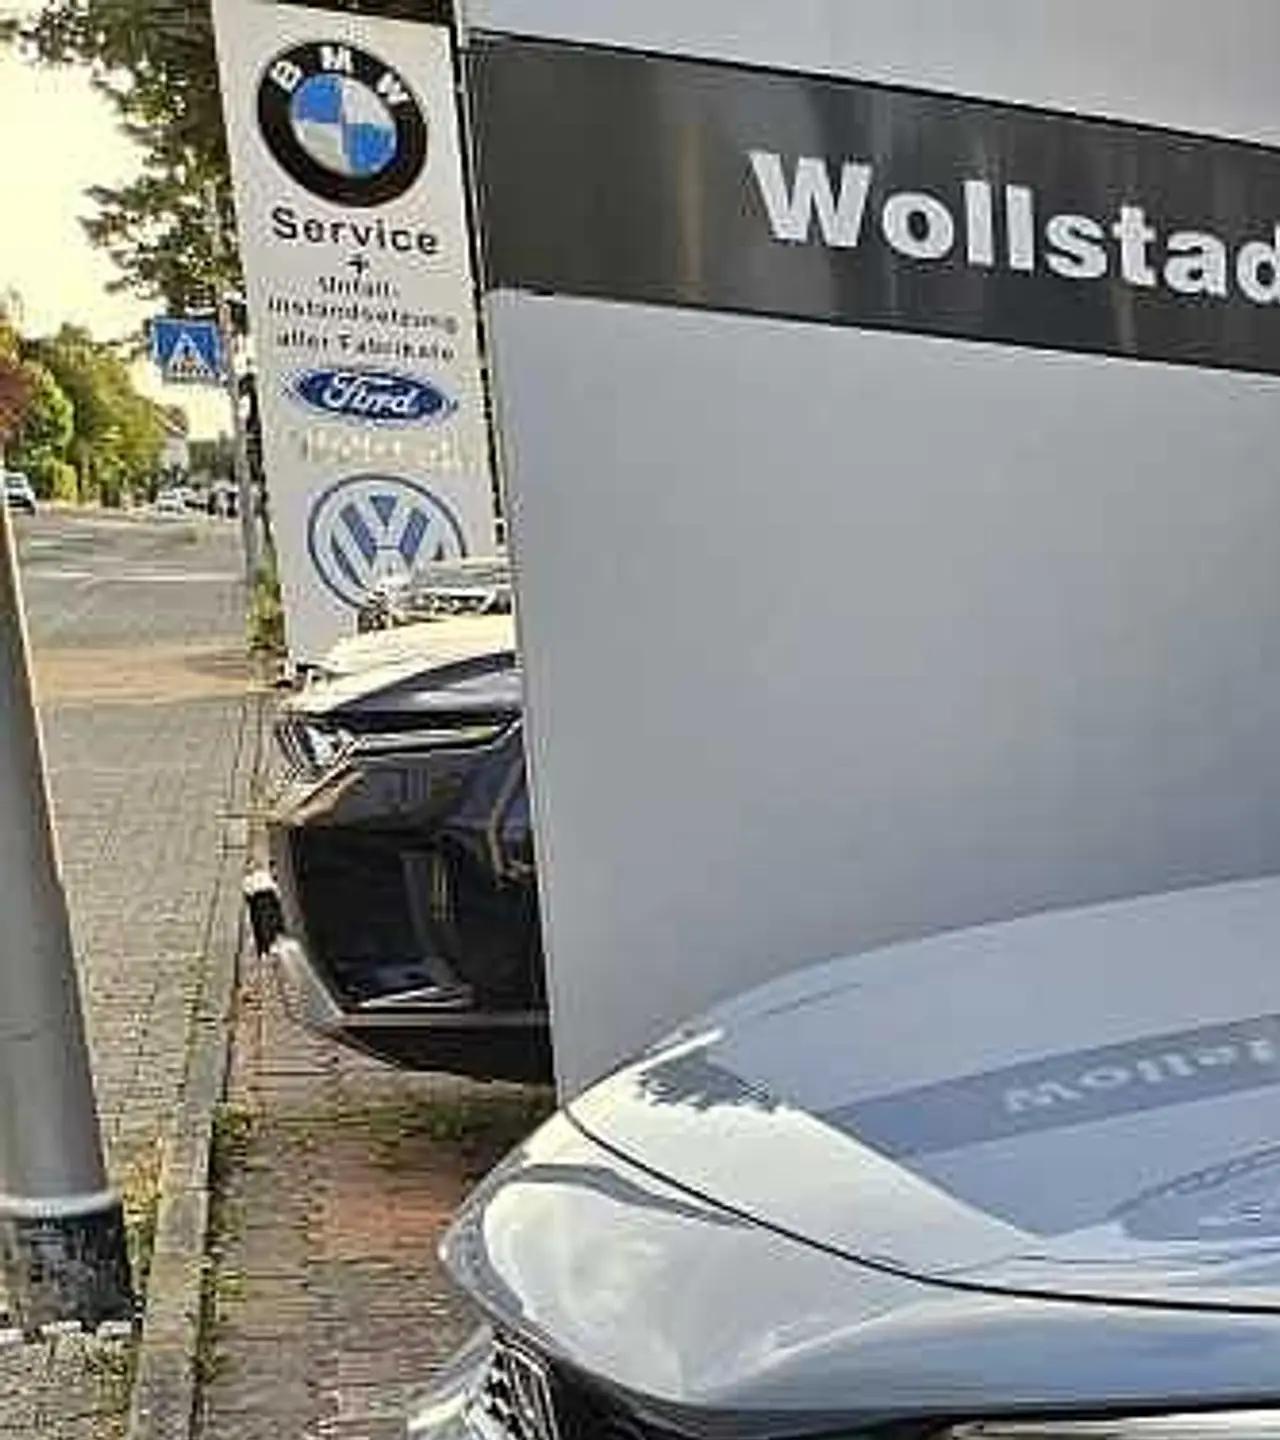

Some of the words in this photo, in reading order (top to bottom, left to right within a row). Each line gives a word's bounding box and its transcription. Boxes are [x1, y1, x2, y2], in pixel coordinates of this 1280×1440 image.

[270, 46, 408, 103] BMW
[271, 206, 438, 254] Service
[322, 373, 421, 412] Ford
